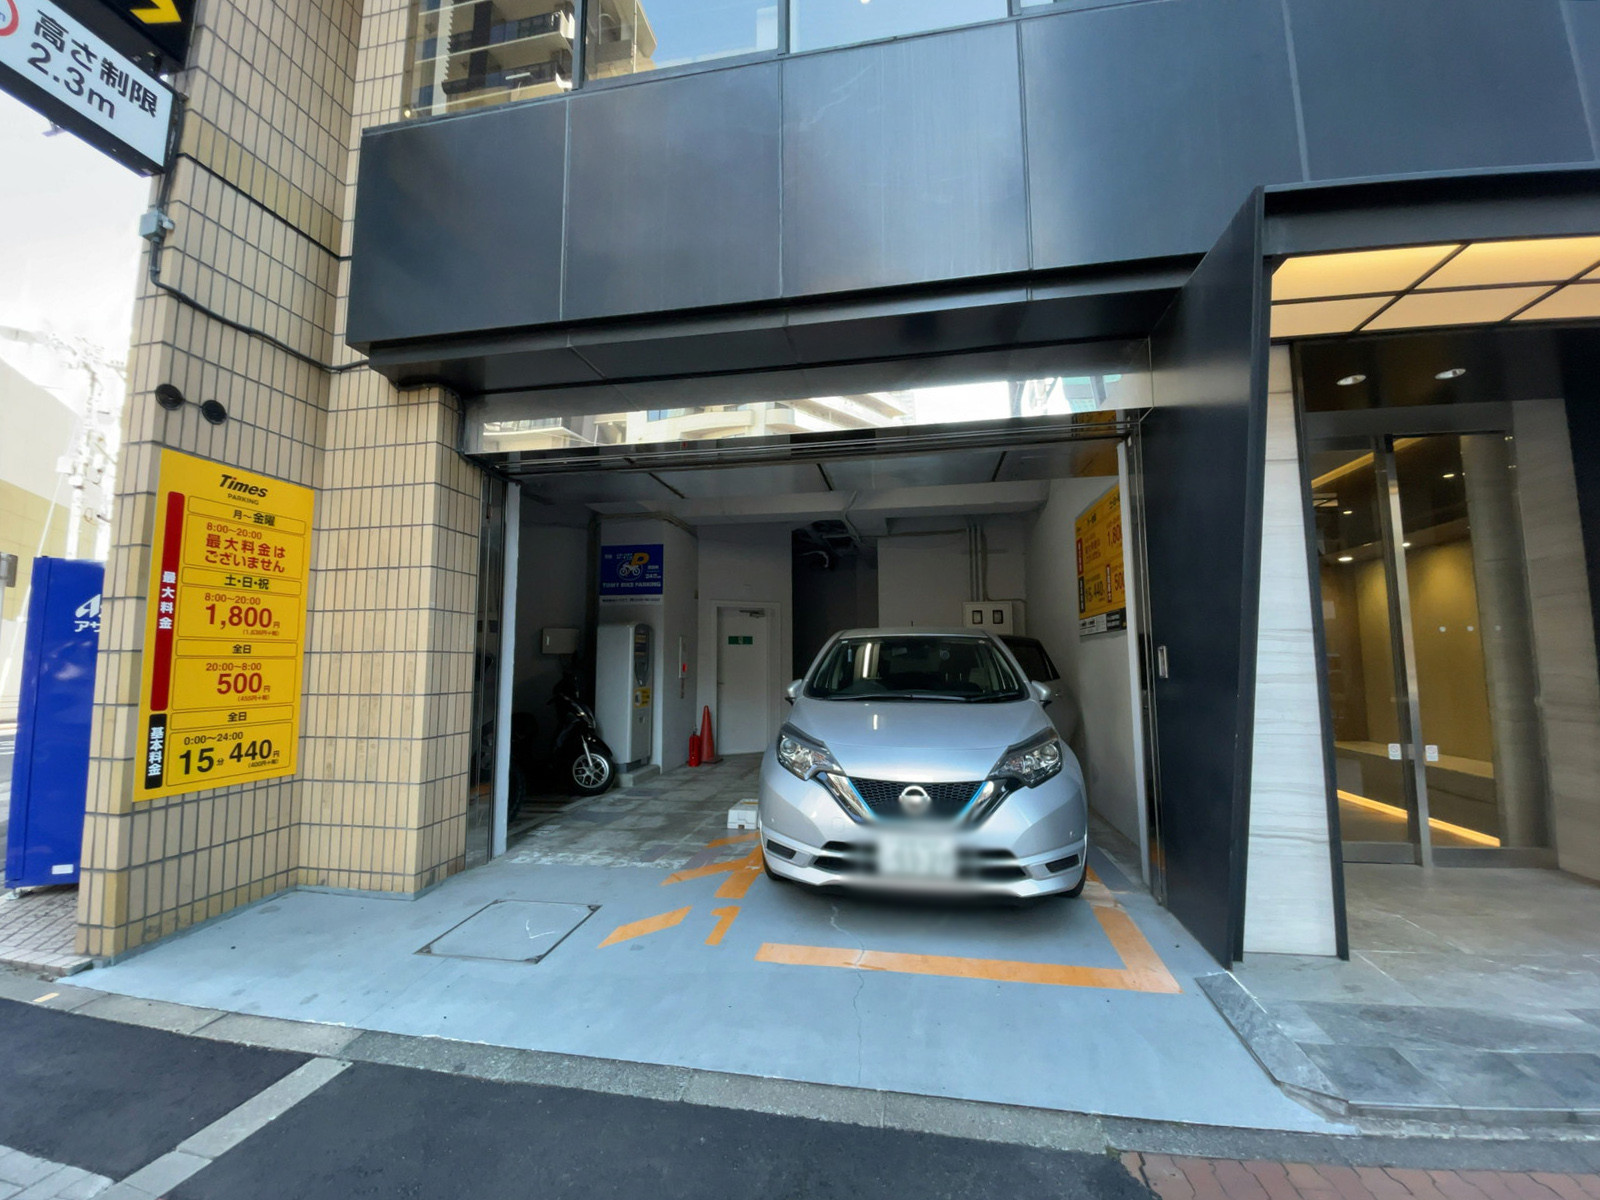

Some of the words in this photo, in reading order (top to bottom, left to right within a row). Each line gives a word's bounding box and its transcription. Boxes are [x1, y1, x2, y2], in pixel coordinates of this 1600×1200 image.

[34, 9, 157, 118] 高さ制限
[27, 41, 116, 120] 2.3m
[219, 474, 269, 498] Times
[227, 493, 259, 506] PARKING
[205, 534, 286, 559] 最大料金は
[204, 551, 285, 573] ございません
[158, 571, 177, 630] 最大料金
[232, 644, 252, 654] 全日
[227, 711, 247, 723] 全日
[147, 726, 165, 777] 基本料金
